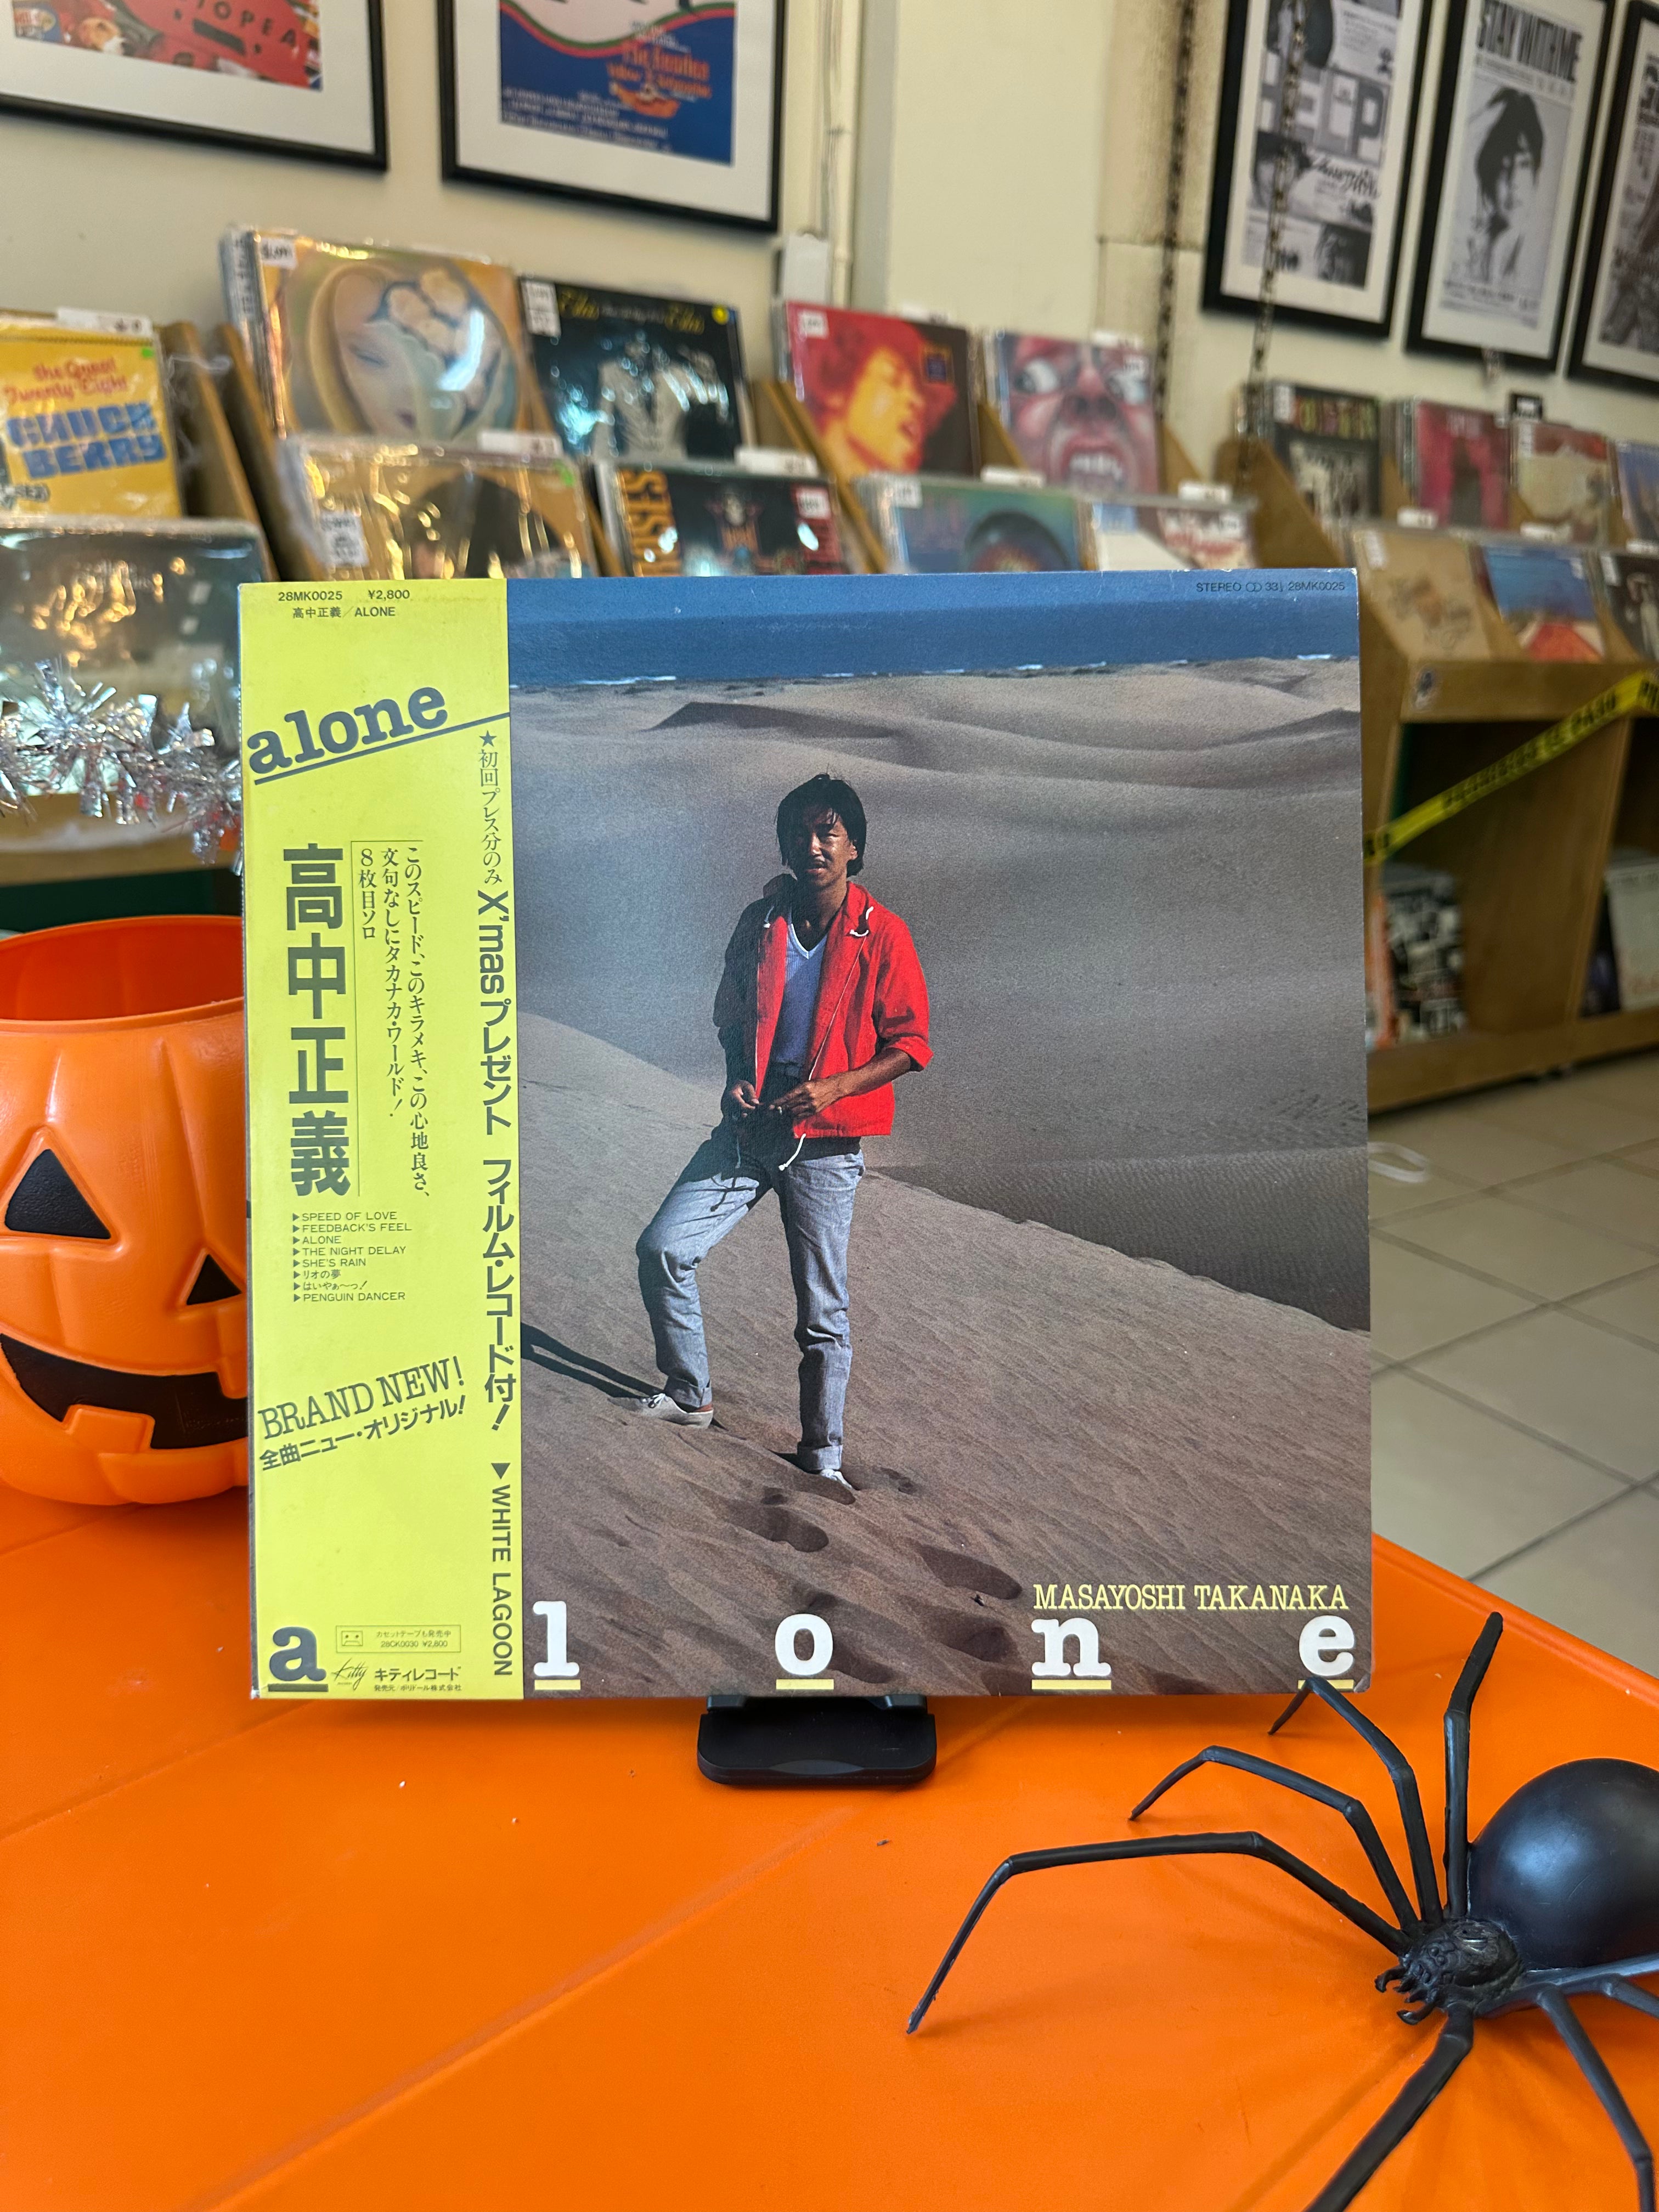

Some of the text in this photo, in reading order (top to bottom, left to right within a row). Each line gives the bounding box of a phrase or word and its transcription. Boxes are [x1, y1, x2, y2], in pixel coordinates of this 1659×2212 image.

[22, 433, 167, 479] BERRY
[1196, 582, 1241, 592] STEREO
[1288, 580, 1346, 591] 28MK0025
[278, 589, 410, 602] 28MK0025 ¥2,800
[247, 686, 448, 775] alone
[283, 843, 351, 1197] 高中正義
[302, 1211, 398, 1221] SPEED OF LOVE
[302, 1223, 413, 1233] FEEDBACK'S FEEL
[302, 1235, 342, 1244] ALONE
[302, 1246, 407, 1256] THE NIGHT DELAY
[302, 1258, 366, 1267] SHE'S RAIN
[303, 1269, 341, 1279] リオの夢
[303, 1292, 405, 1302] PENGUIN DANCER
[258, 1355, 465, 1440] BRAND NEW!
[491, 1483, 513, 1676] WHITE LAGOON
[1033, 1584, 1349, 1610] MASAYOSHI TAKANAKA
[331, 1657, 369, 1691] Kitty
[374, 1666, 461, 1682] キティレコード
